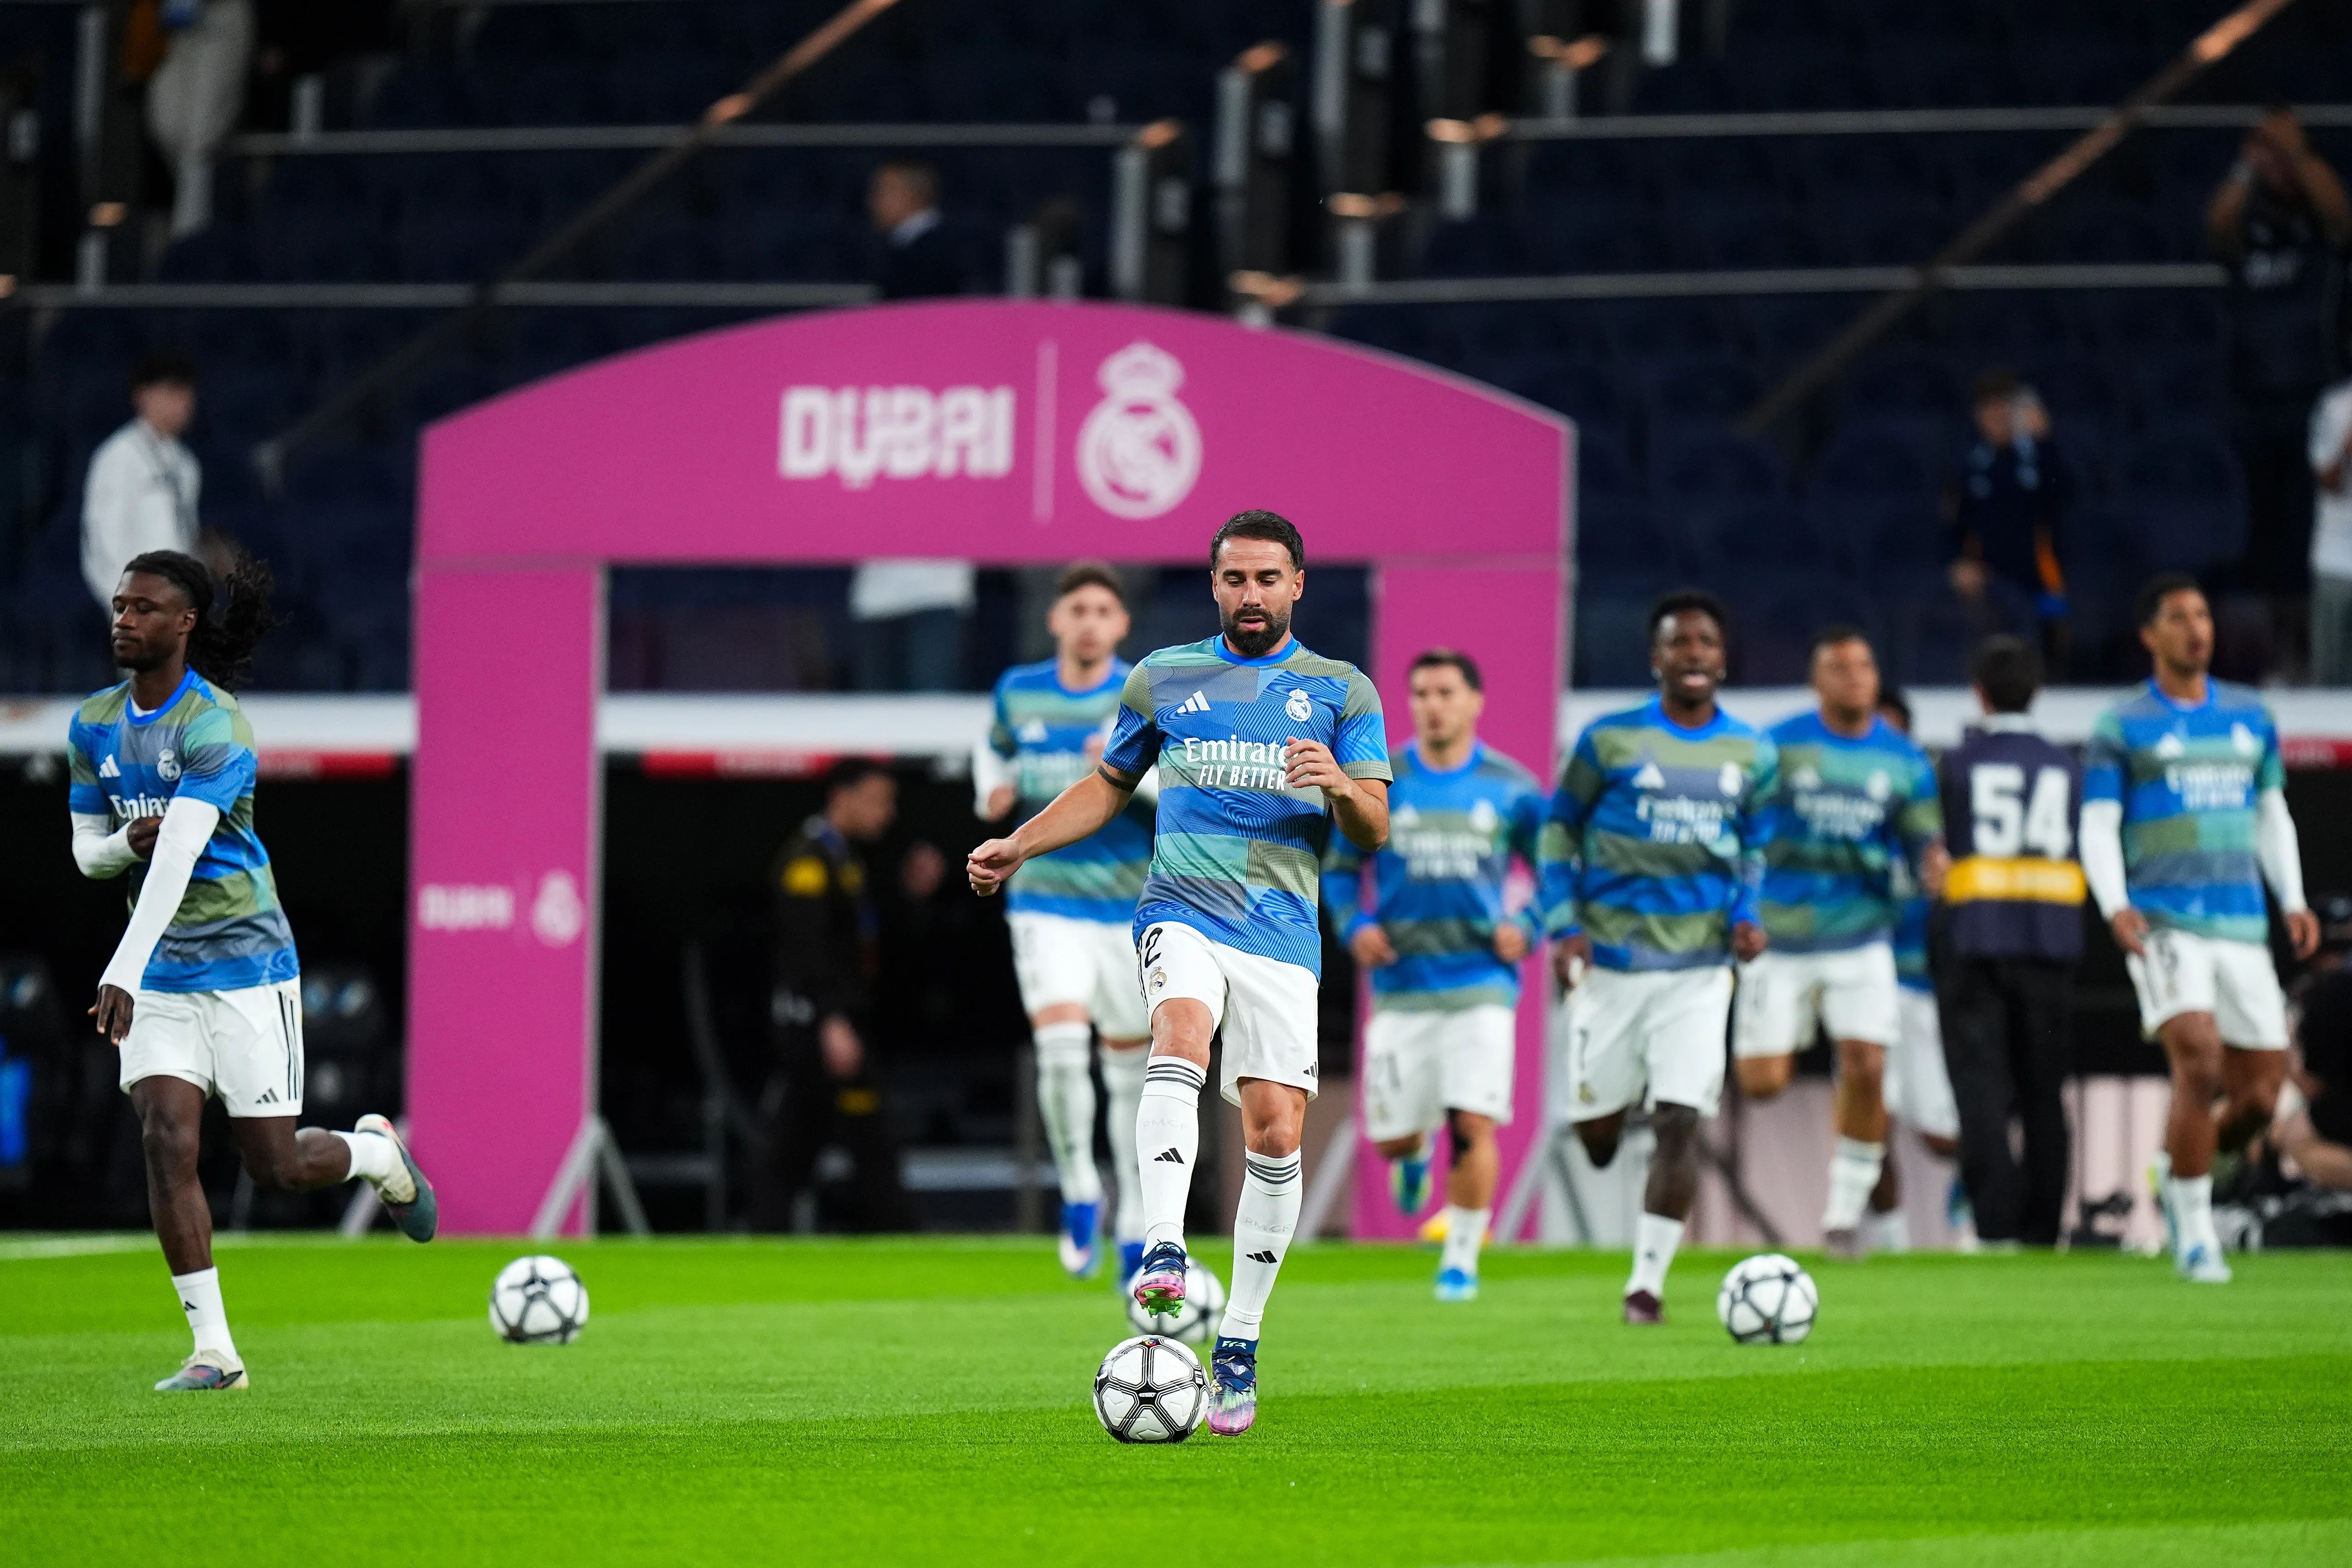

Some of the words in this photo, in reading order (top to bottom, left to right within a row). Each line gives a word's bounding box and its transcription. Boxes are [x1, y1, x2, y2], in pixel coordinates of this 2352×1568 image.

[779, 384, 1016, 489] DUBAI
[1183, 734, 1302, 769] Emirate
[1198, 765, 1225, 786] FLY
[1229, 765, 1286, 791] BETTER
[1971, 763, 2070, 862] 54
[1144, 927, 1163, 969] 2
[1143, 1118, 1188, 1130] RMCF
